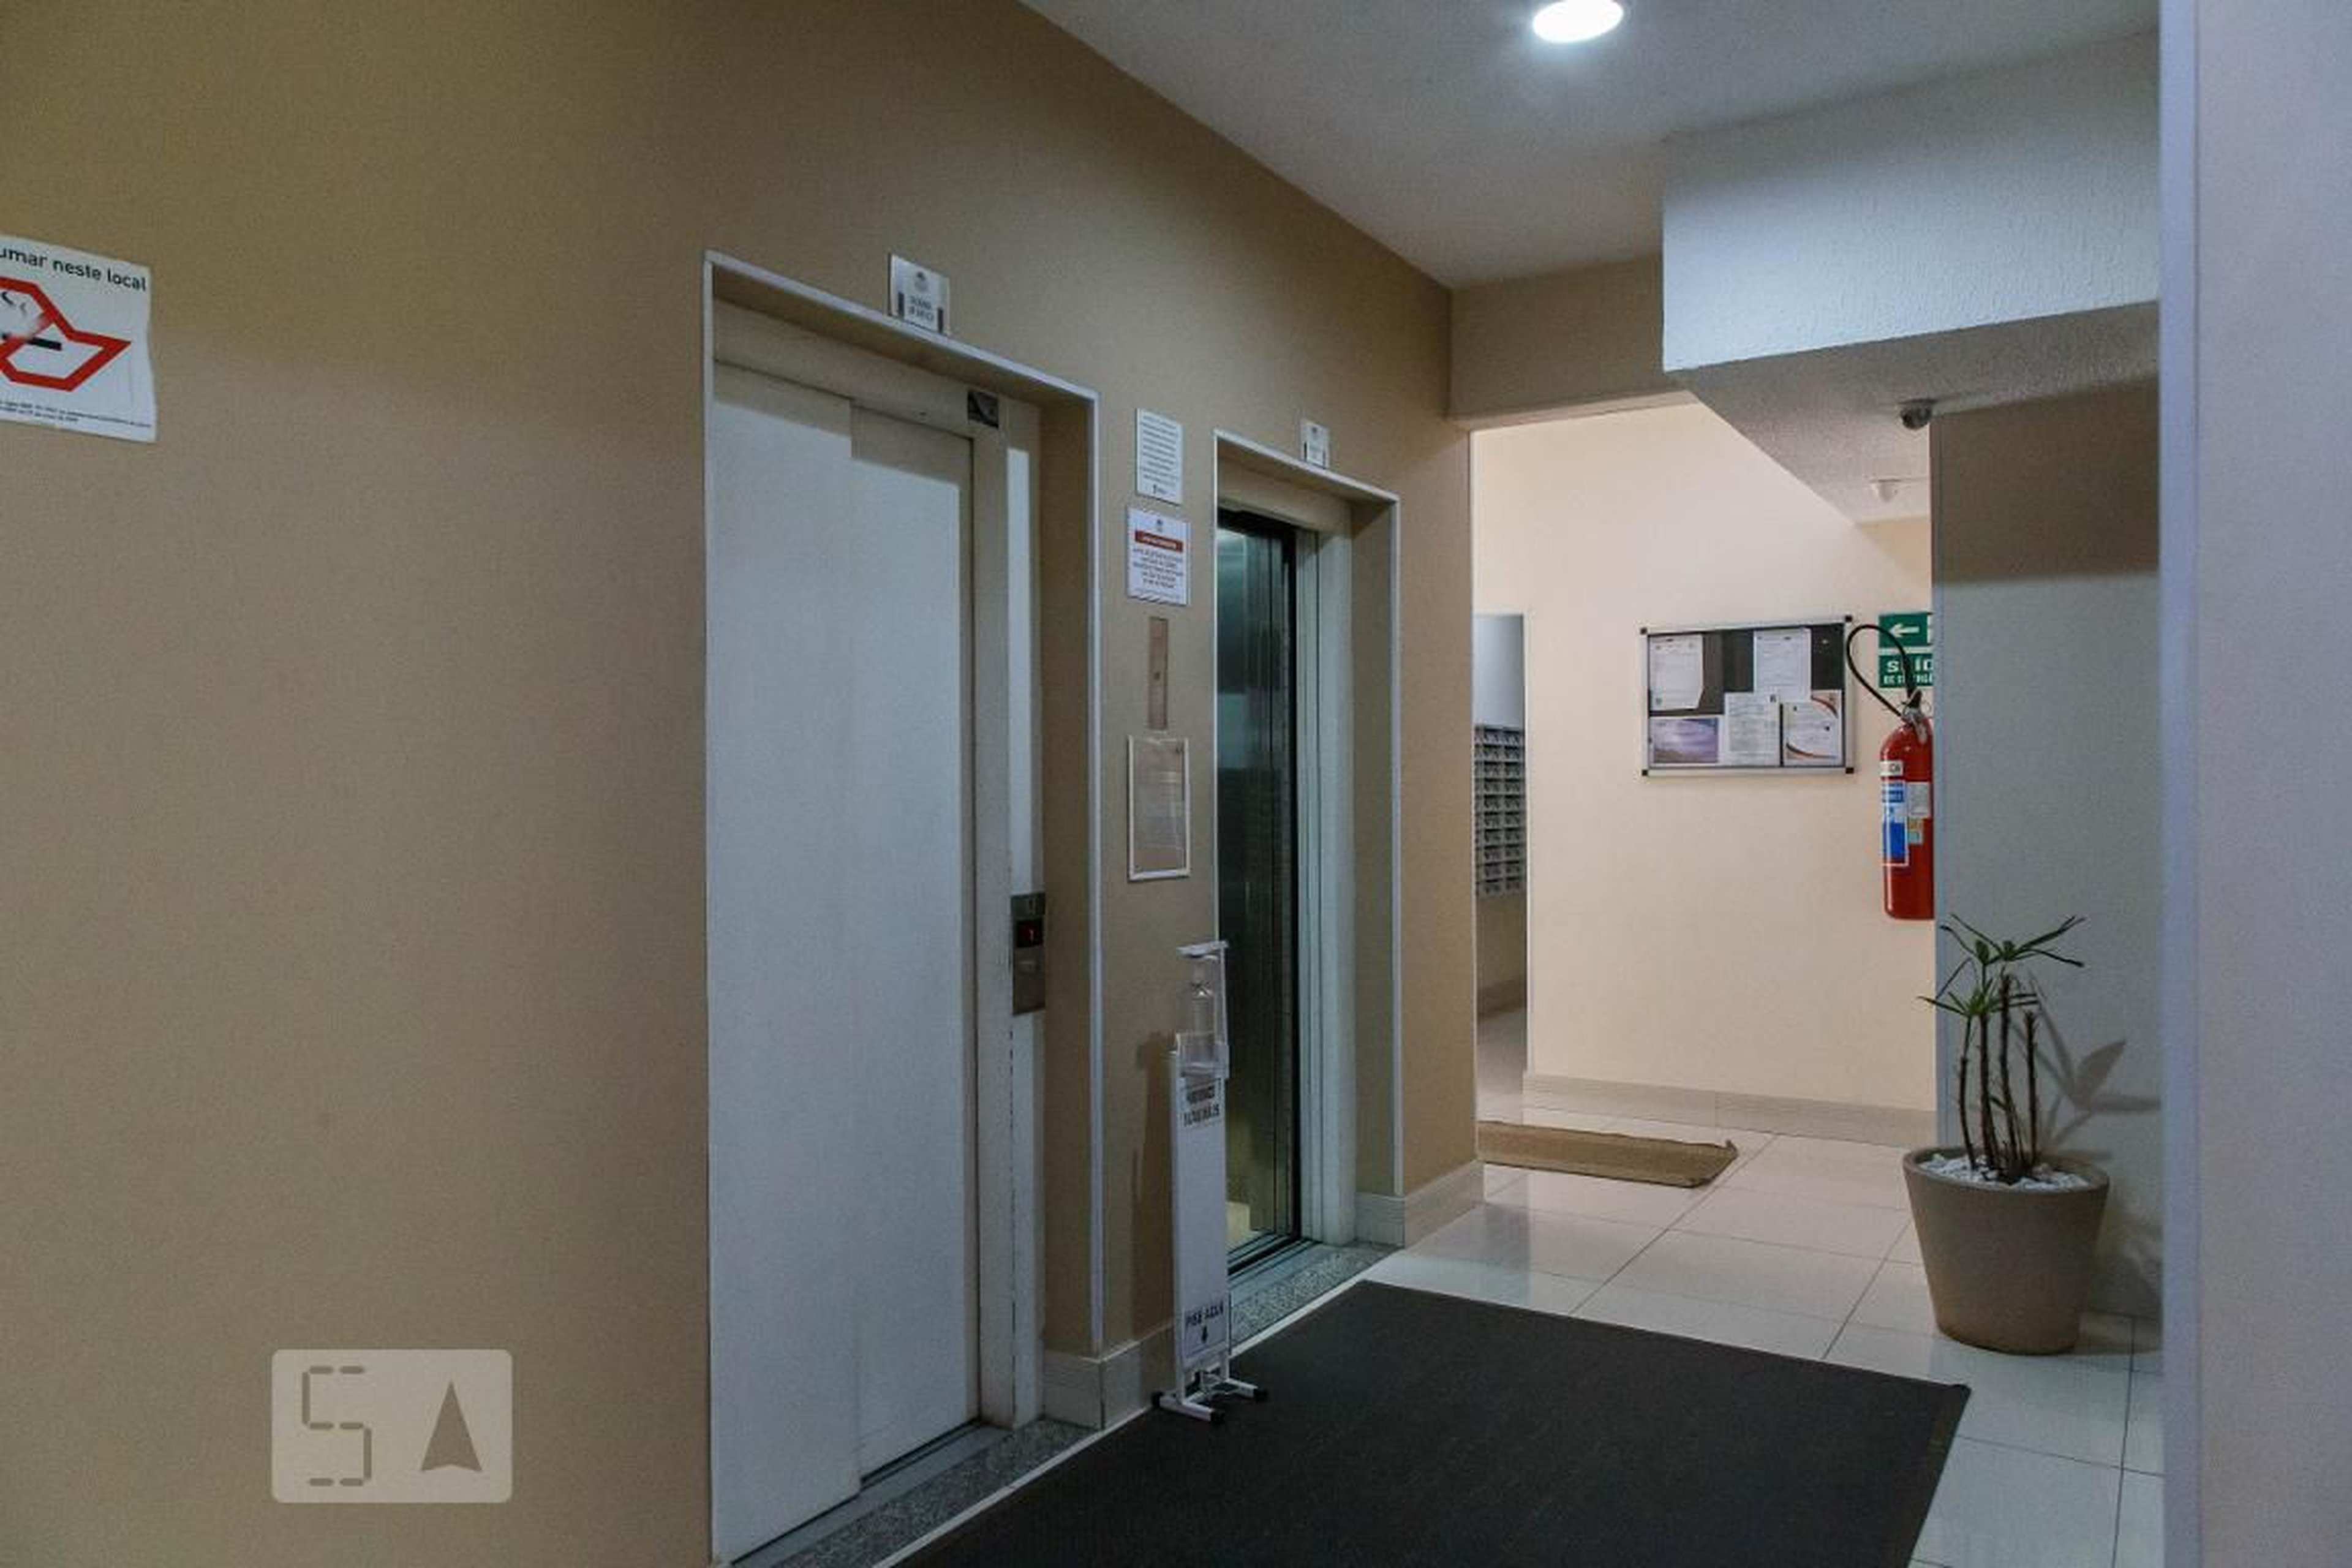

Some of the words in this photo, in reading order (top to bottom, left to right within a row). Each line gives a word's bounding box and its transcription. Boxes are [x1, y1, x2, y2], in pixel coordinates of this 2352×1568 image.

[0, 248, 47, 268] umar
[53, 260, 101, 281] neste
[108, 268, 146, 292] local
